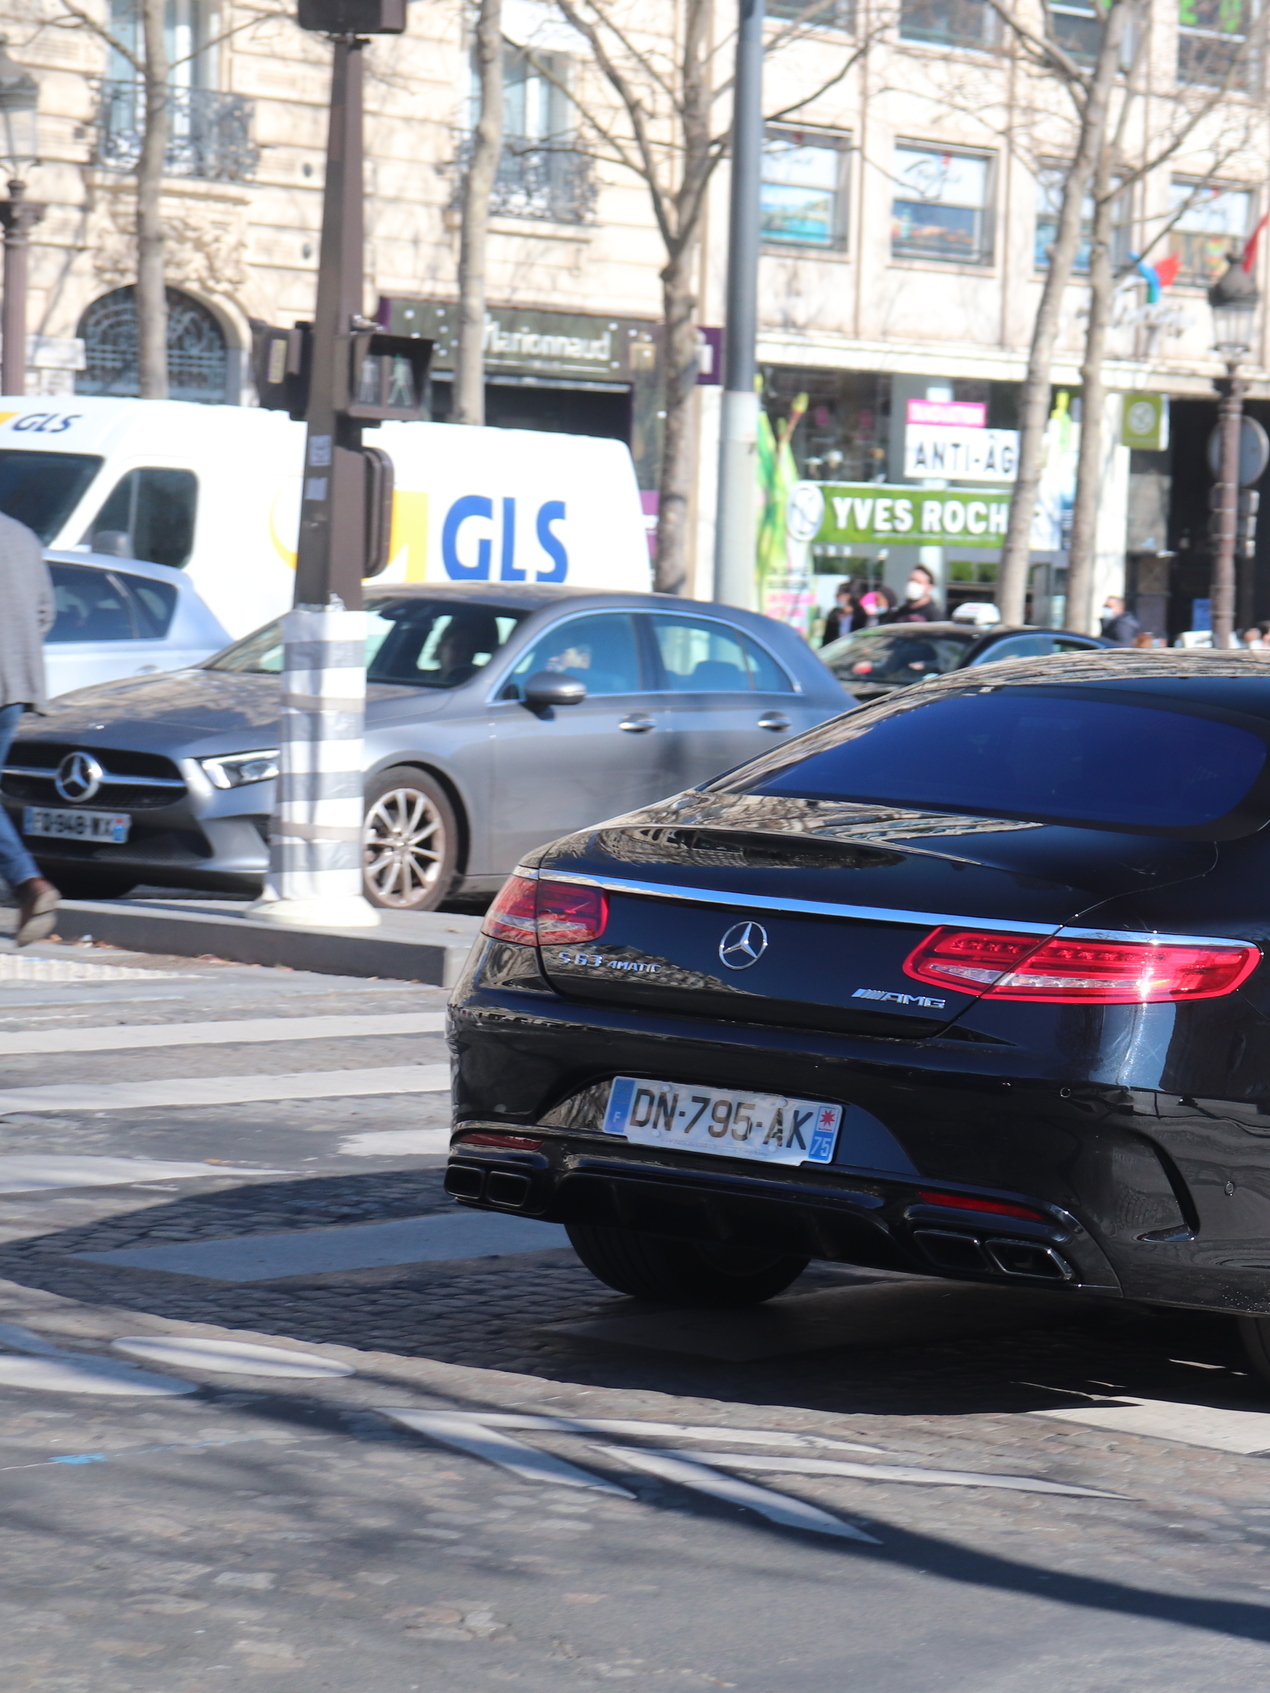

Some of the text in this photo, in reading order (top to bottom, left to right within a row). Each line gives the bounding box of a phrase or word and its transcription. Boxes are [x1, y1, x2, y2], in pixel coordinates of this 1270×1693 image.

[11, 413, 83, 433] GLS
[832, 497, 914, 532] YVES
[442, 495, 569, 584] GLS
[574, 953, 602, 967] 63
[607, 960, 662, 973] 4MATIC
[880, 991, 947, 1009] AMG
[613, 1112, 621, 1123] F
[629, 1088, 814, 1150] DN-795-AK
[810, 1136, 831, 1157] 75
